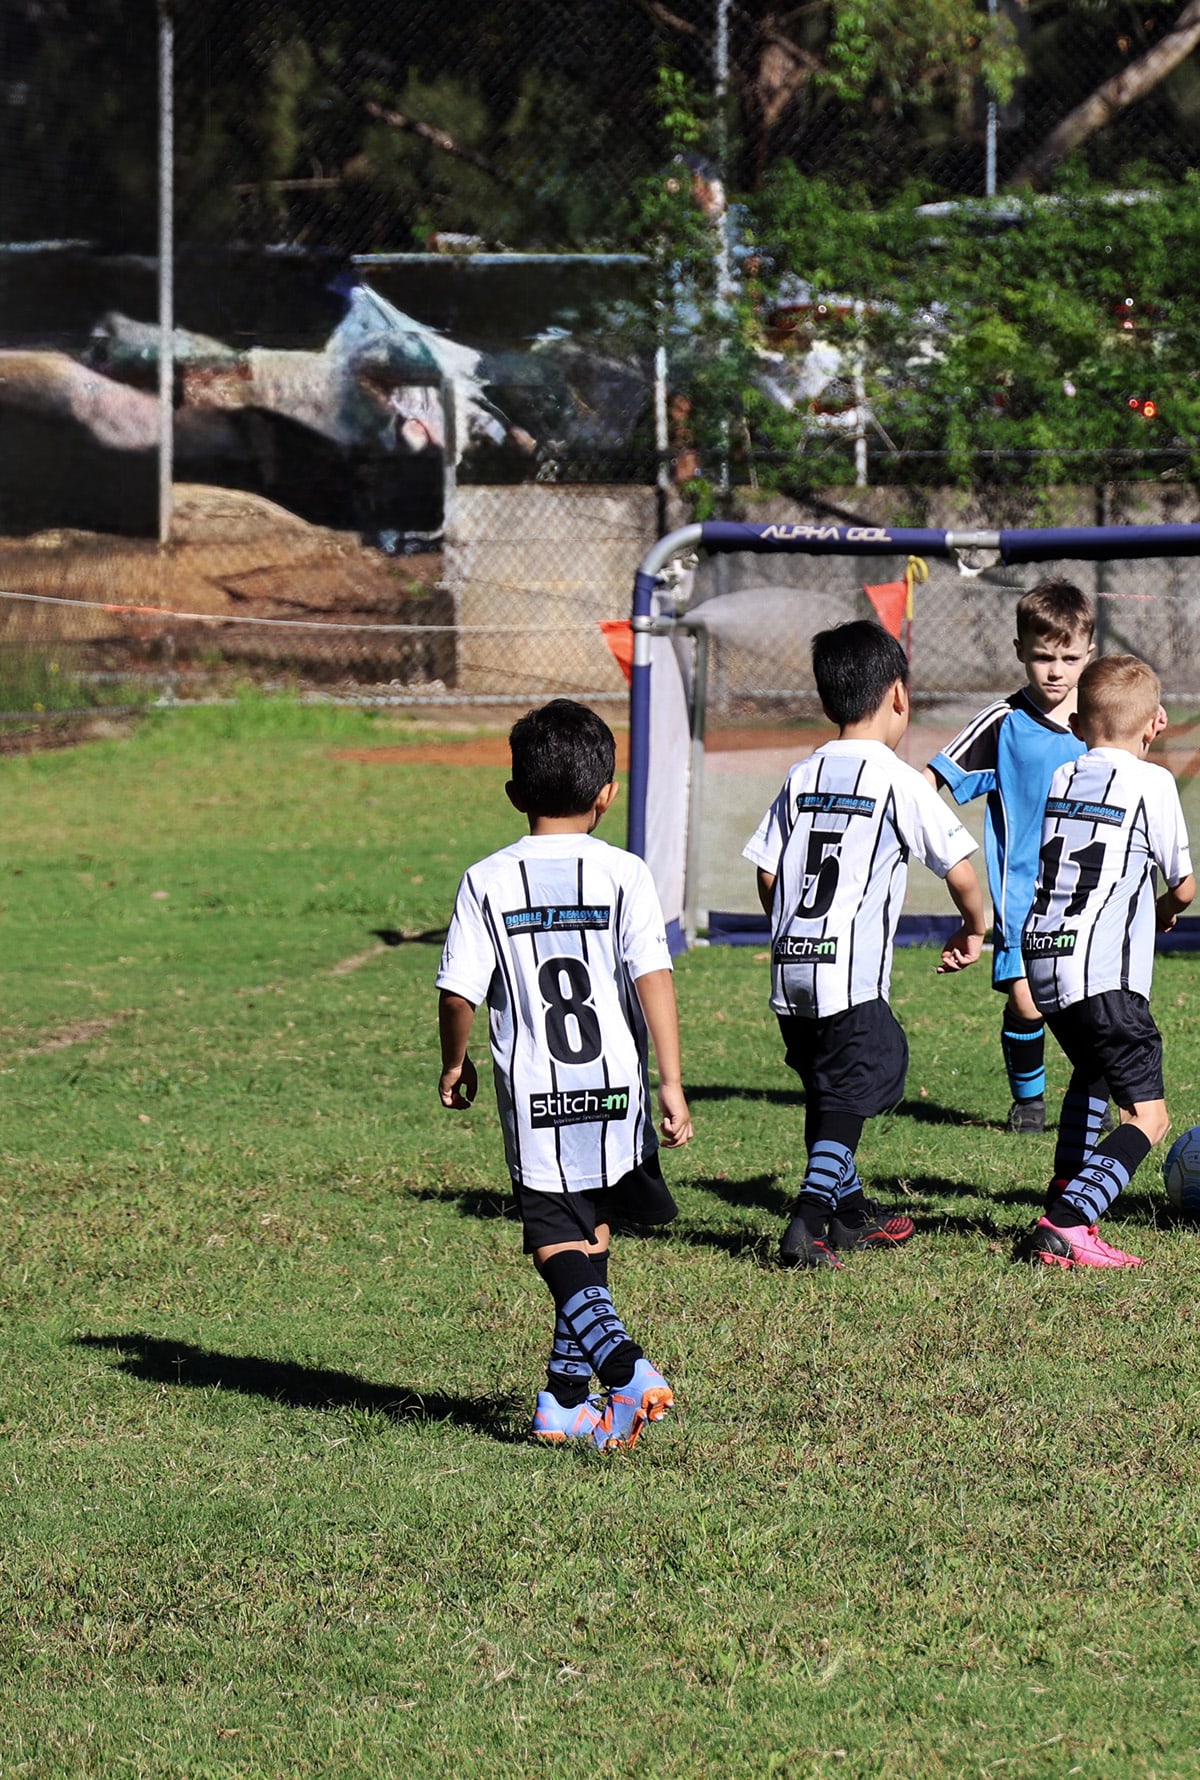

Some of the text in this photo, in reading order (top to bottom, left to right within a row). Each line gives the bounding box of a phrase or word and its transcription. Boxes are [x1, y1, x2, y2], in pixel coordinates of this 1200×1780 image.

[760, 524, 840, 541] ALPHA
[797, 831, 843, 919] 5
[1033, 835, 1107, 917] 11
[505, 911, 542, 925] DOUBLE
[543, 907, 556, 929] J
[538, 957, 603, 1065] 8
